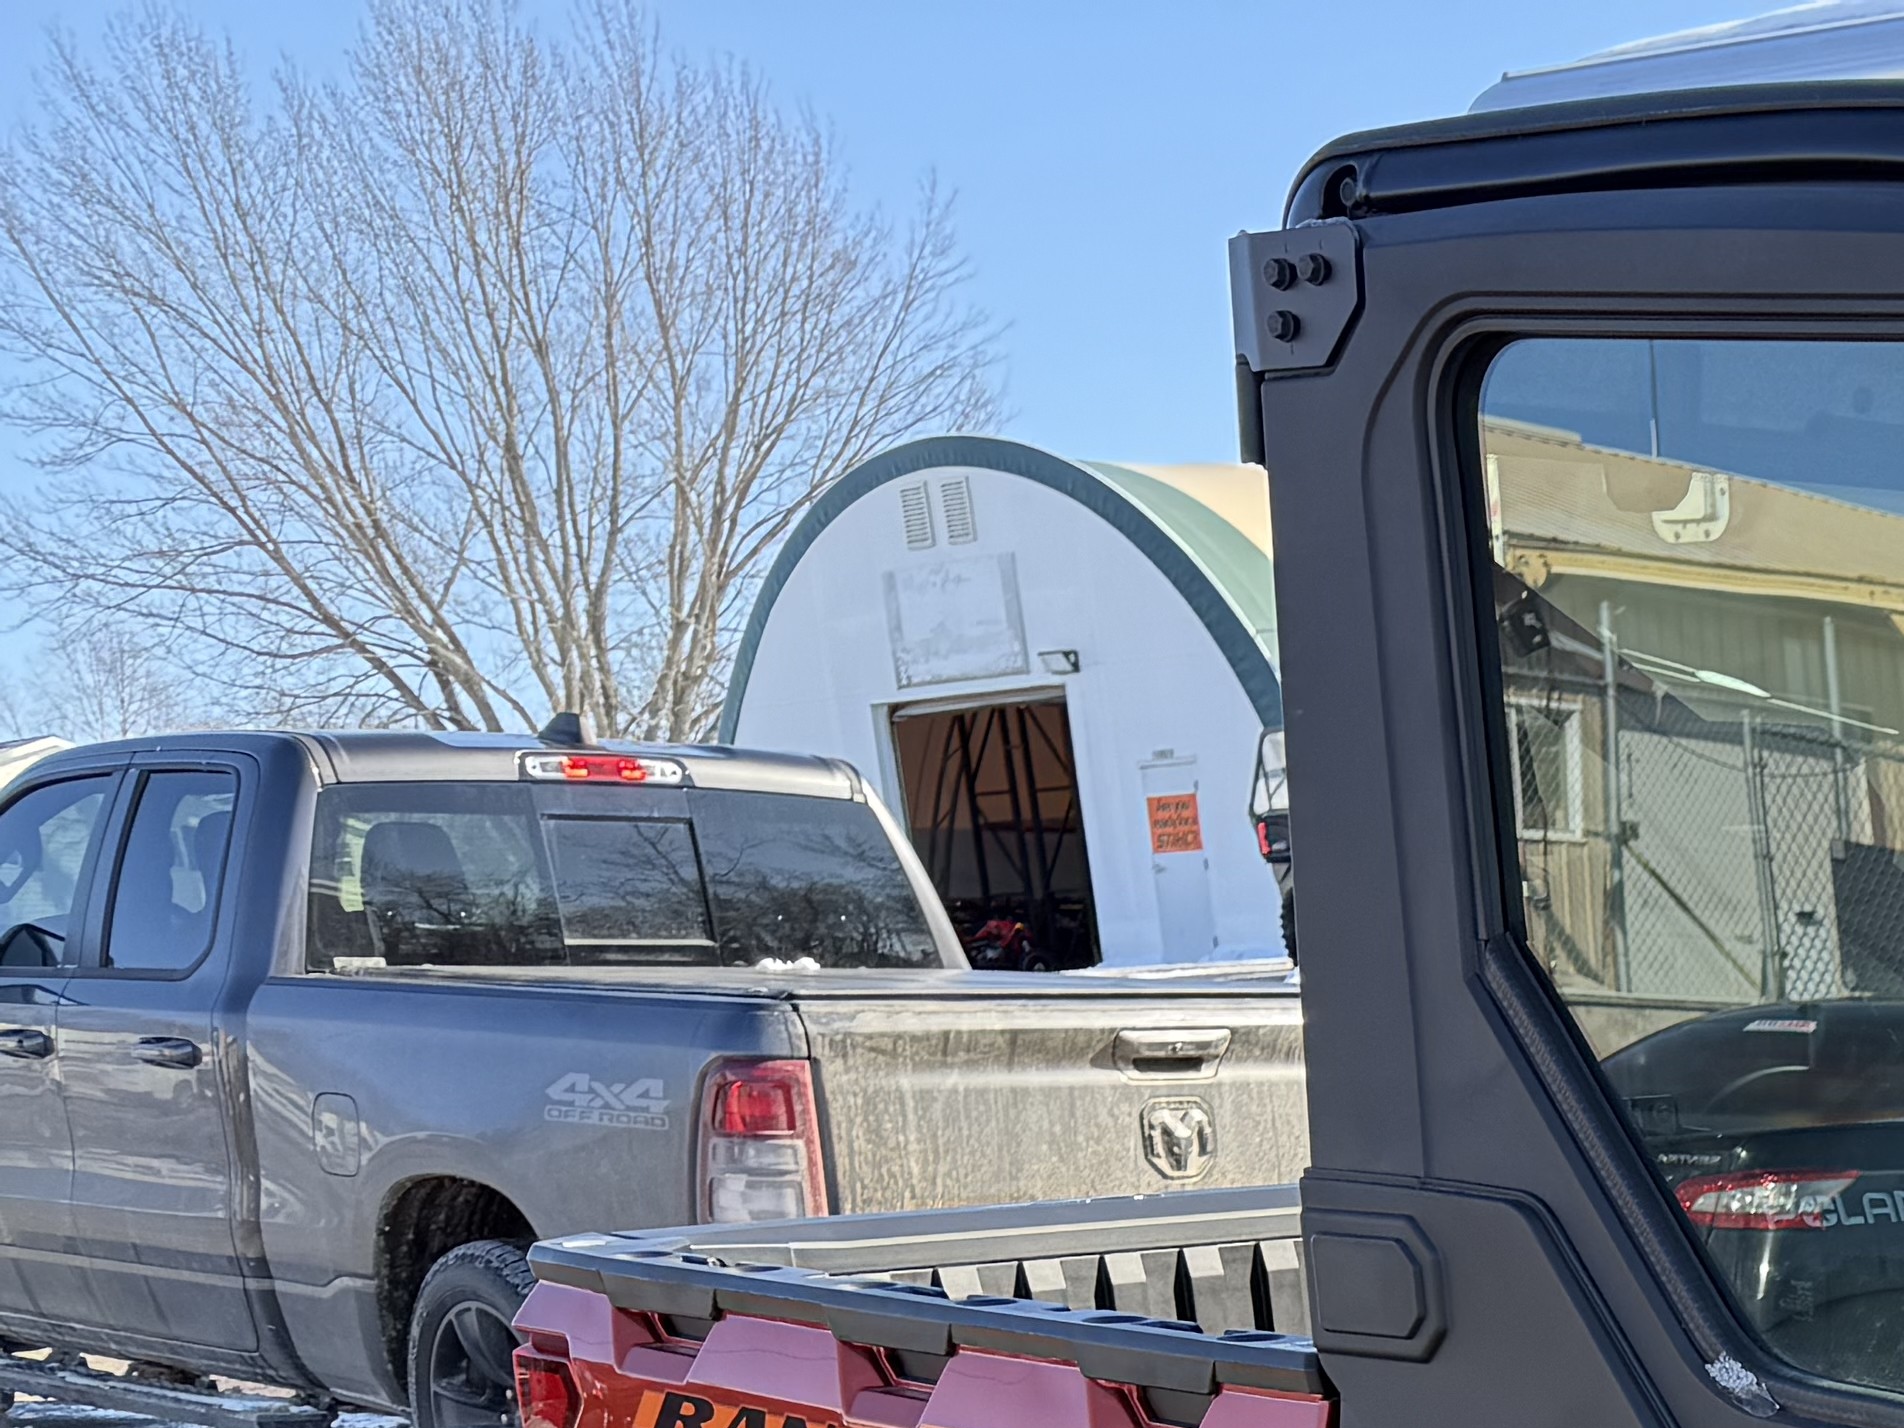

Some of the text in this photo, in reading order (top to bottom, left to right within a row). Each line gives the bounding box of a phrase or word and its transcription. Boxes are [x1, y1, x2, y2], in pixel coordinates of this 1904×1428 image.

[545, 1072, 671, 1113] 4x4
[547, 1108, 667, 1129] OFF ROAD
